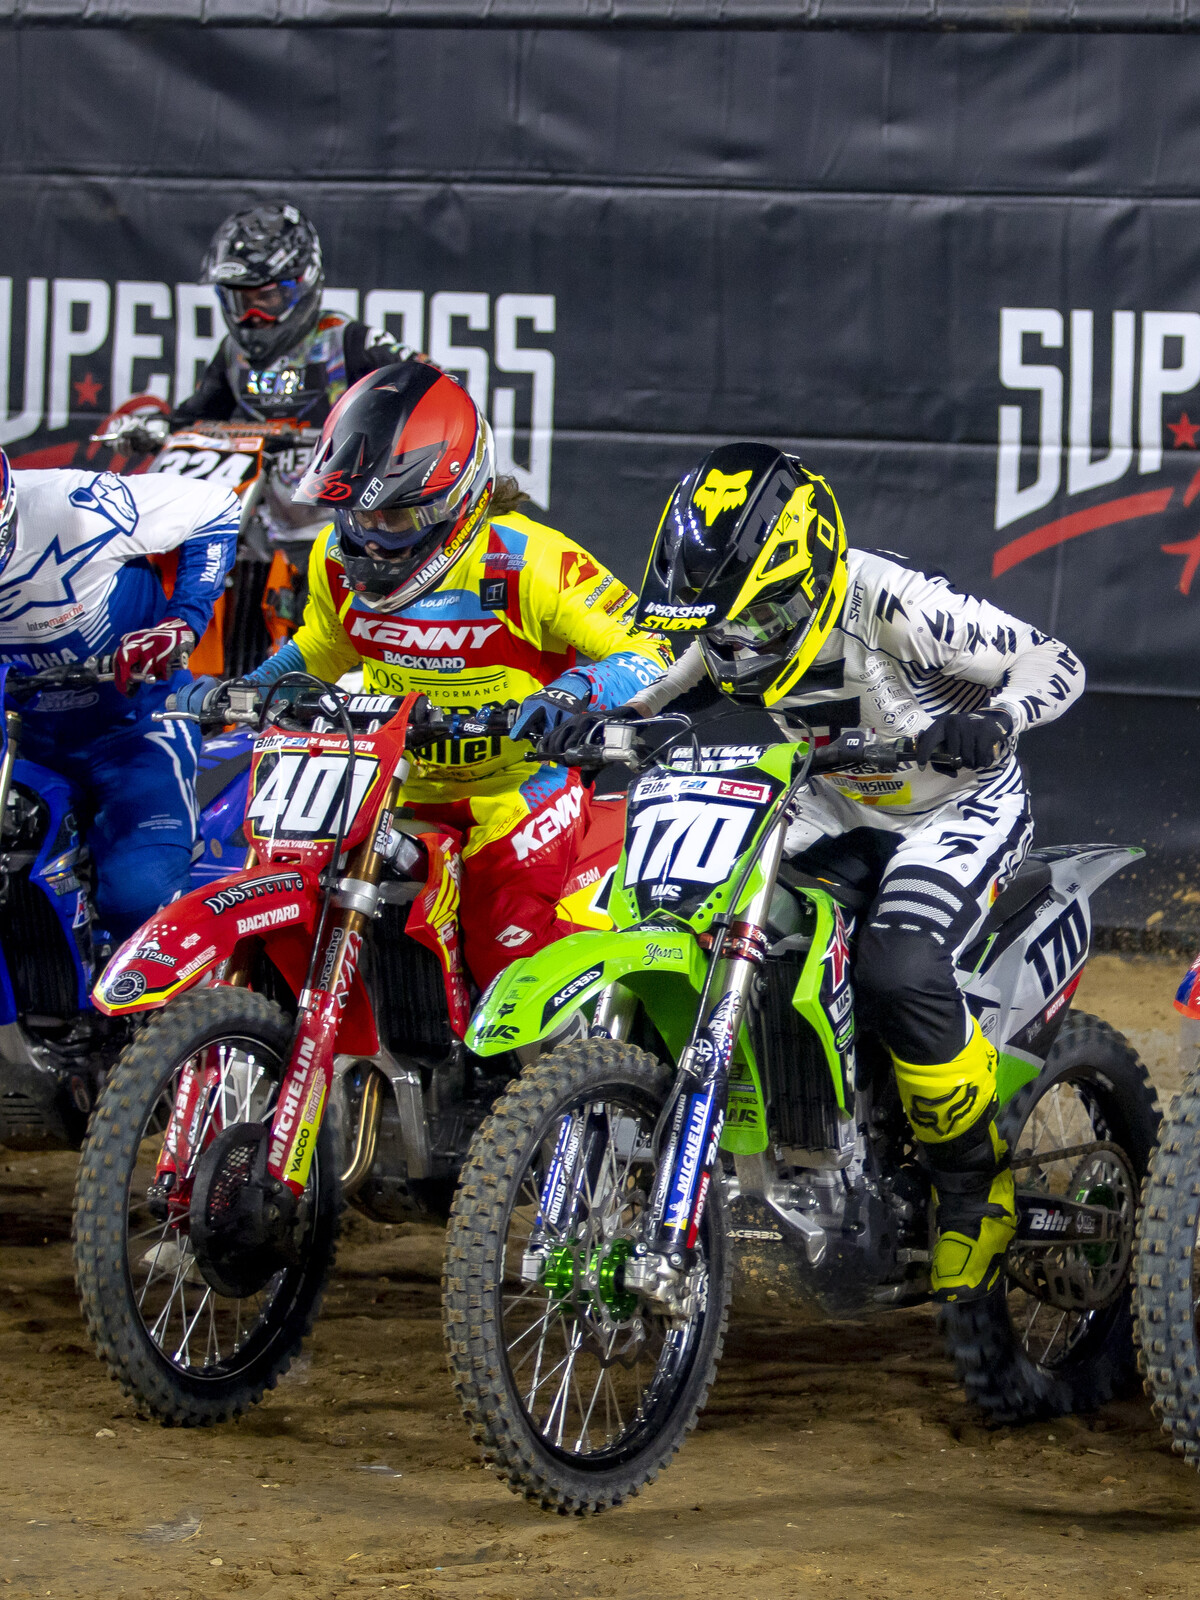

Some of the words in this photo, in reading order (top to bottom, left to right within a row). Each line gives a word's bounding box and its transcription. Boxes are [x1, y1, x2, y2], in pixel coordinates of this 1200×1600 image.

[850, 581, 864, 622] SHIFT
[350, 617, 503, 650] KENNY
[383, 652, 466, 669] BACKYARD
[641, 779, 671, 795] Bihr
[511, 785, 583, 860] KENNY
[624, 801, 756, 886] 170
[203, 886, 246, 915] DOS
[245, 878, 304, 899] RACING
[237, 903, 300, 934] BACKYARD
[1024, 898, 1089, 1000] 170
[553, 970, 601, 1007] ACERBIS
[267, 1036, 316, 1167] MICHELIN
[290, 1128, 310, 1173] YACCO
[676, 1101, 707, 1194] MICHELIN
[1028, 1207, 1073, 1232] Bihr
